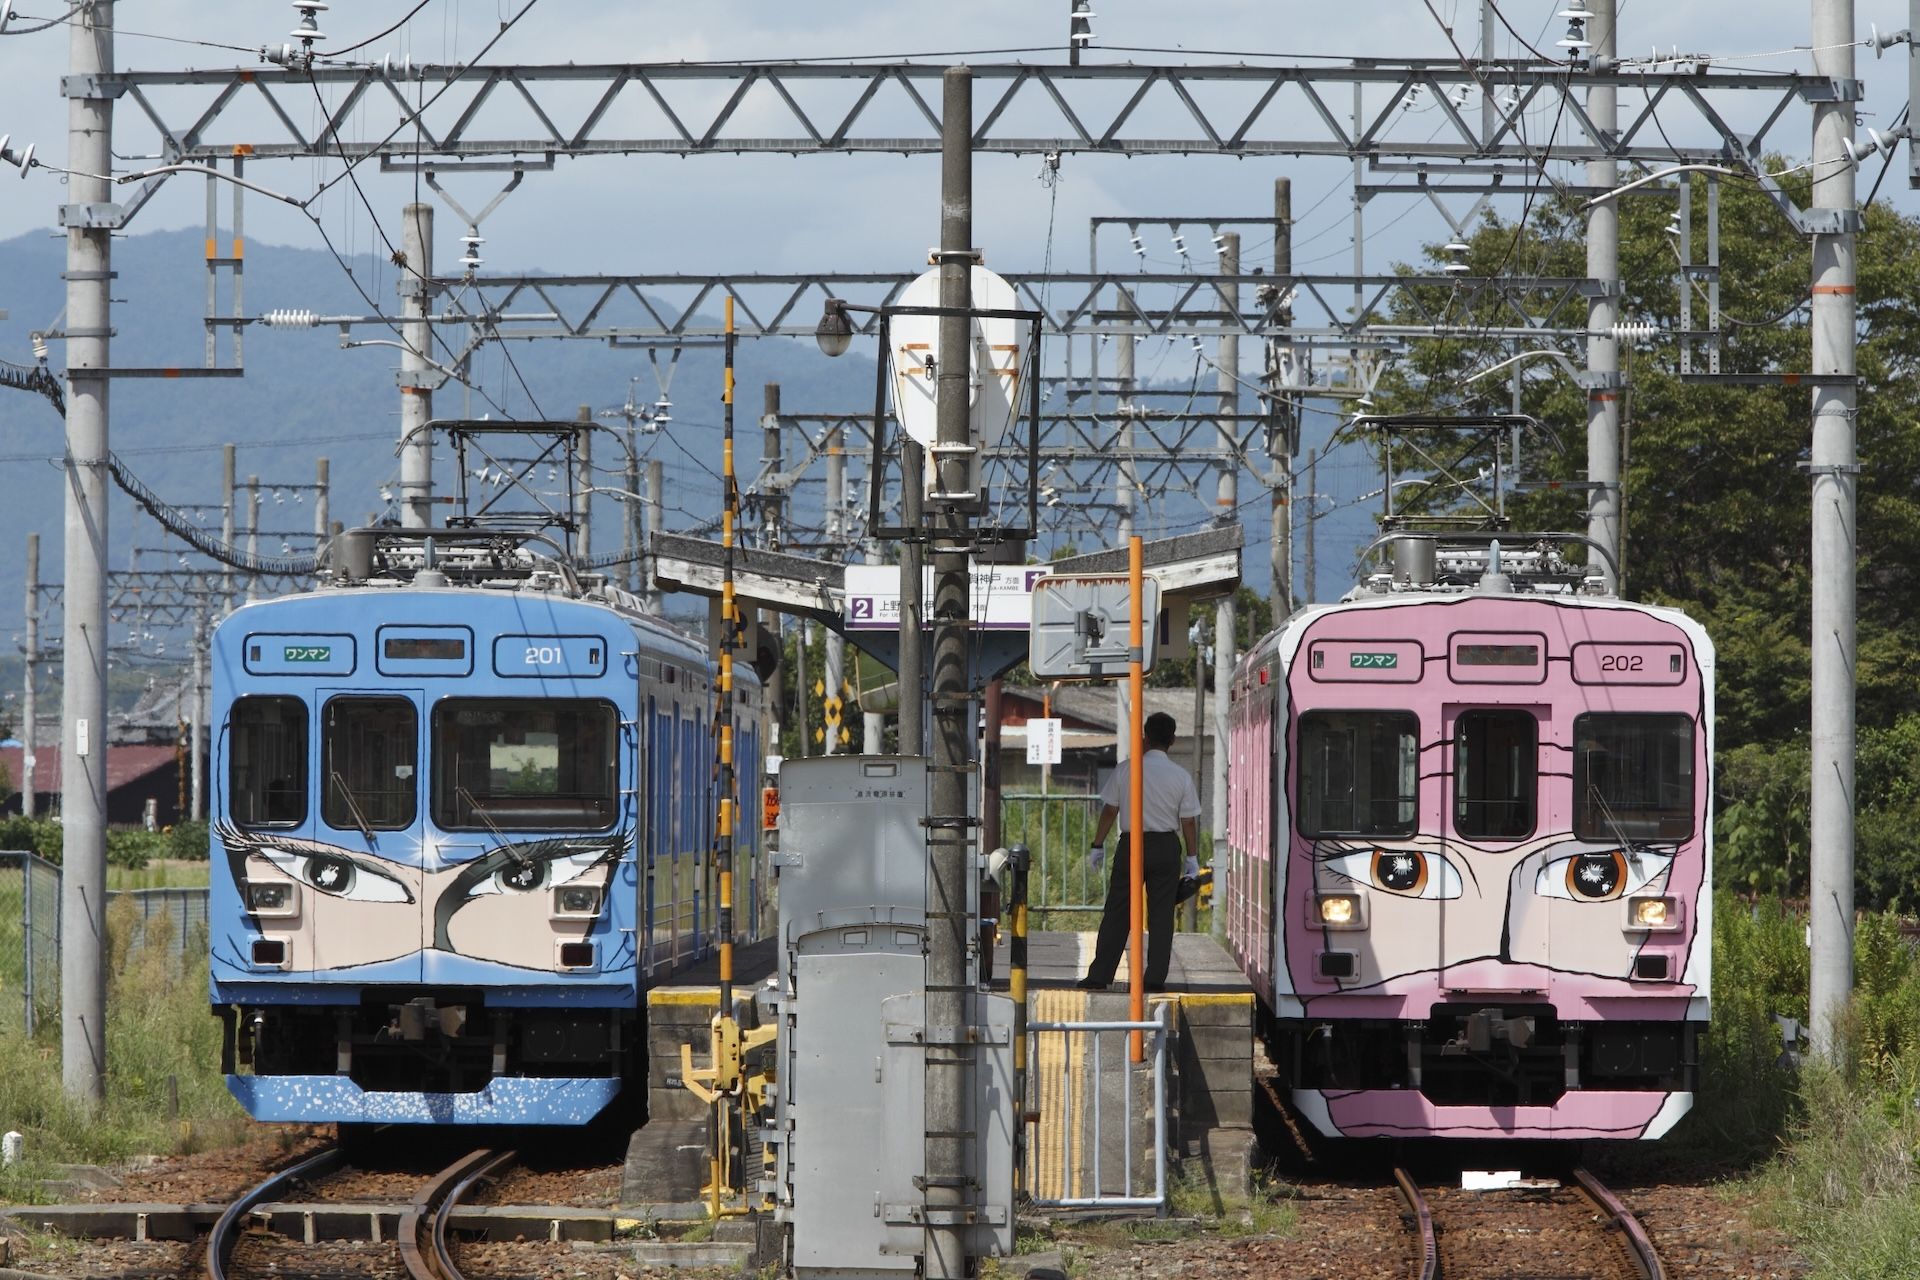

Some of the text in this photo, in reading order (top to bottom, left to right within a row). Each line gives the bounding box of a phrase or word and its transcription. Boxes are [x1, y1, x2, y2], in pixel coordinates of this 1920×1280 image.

[855, 599, 868, 618] 2
[286, 648, 330, 660] ワンマン
[525, 647, 561, 664] 201
[1352, 655, 1396, 666] ワンマン
[1602, 655, 1643, 671] 202
